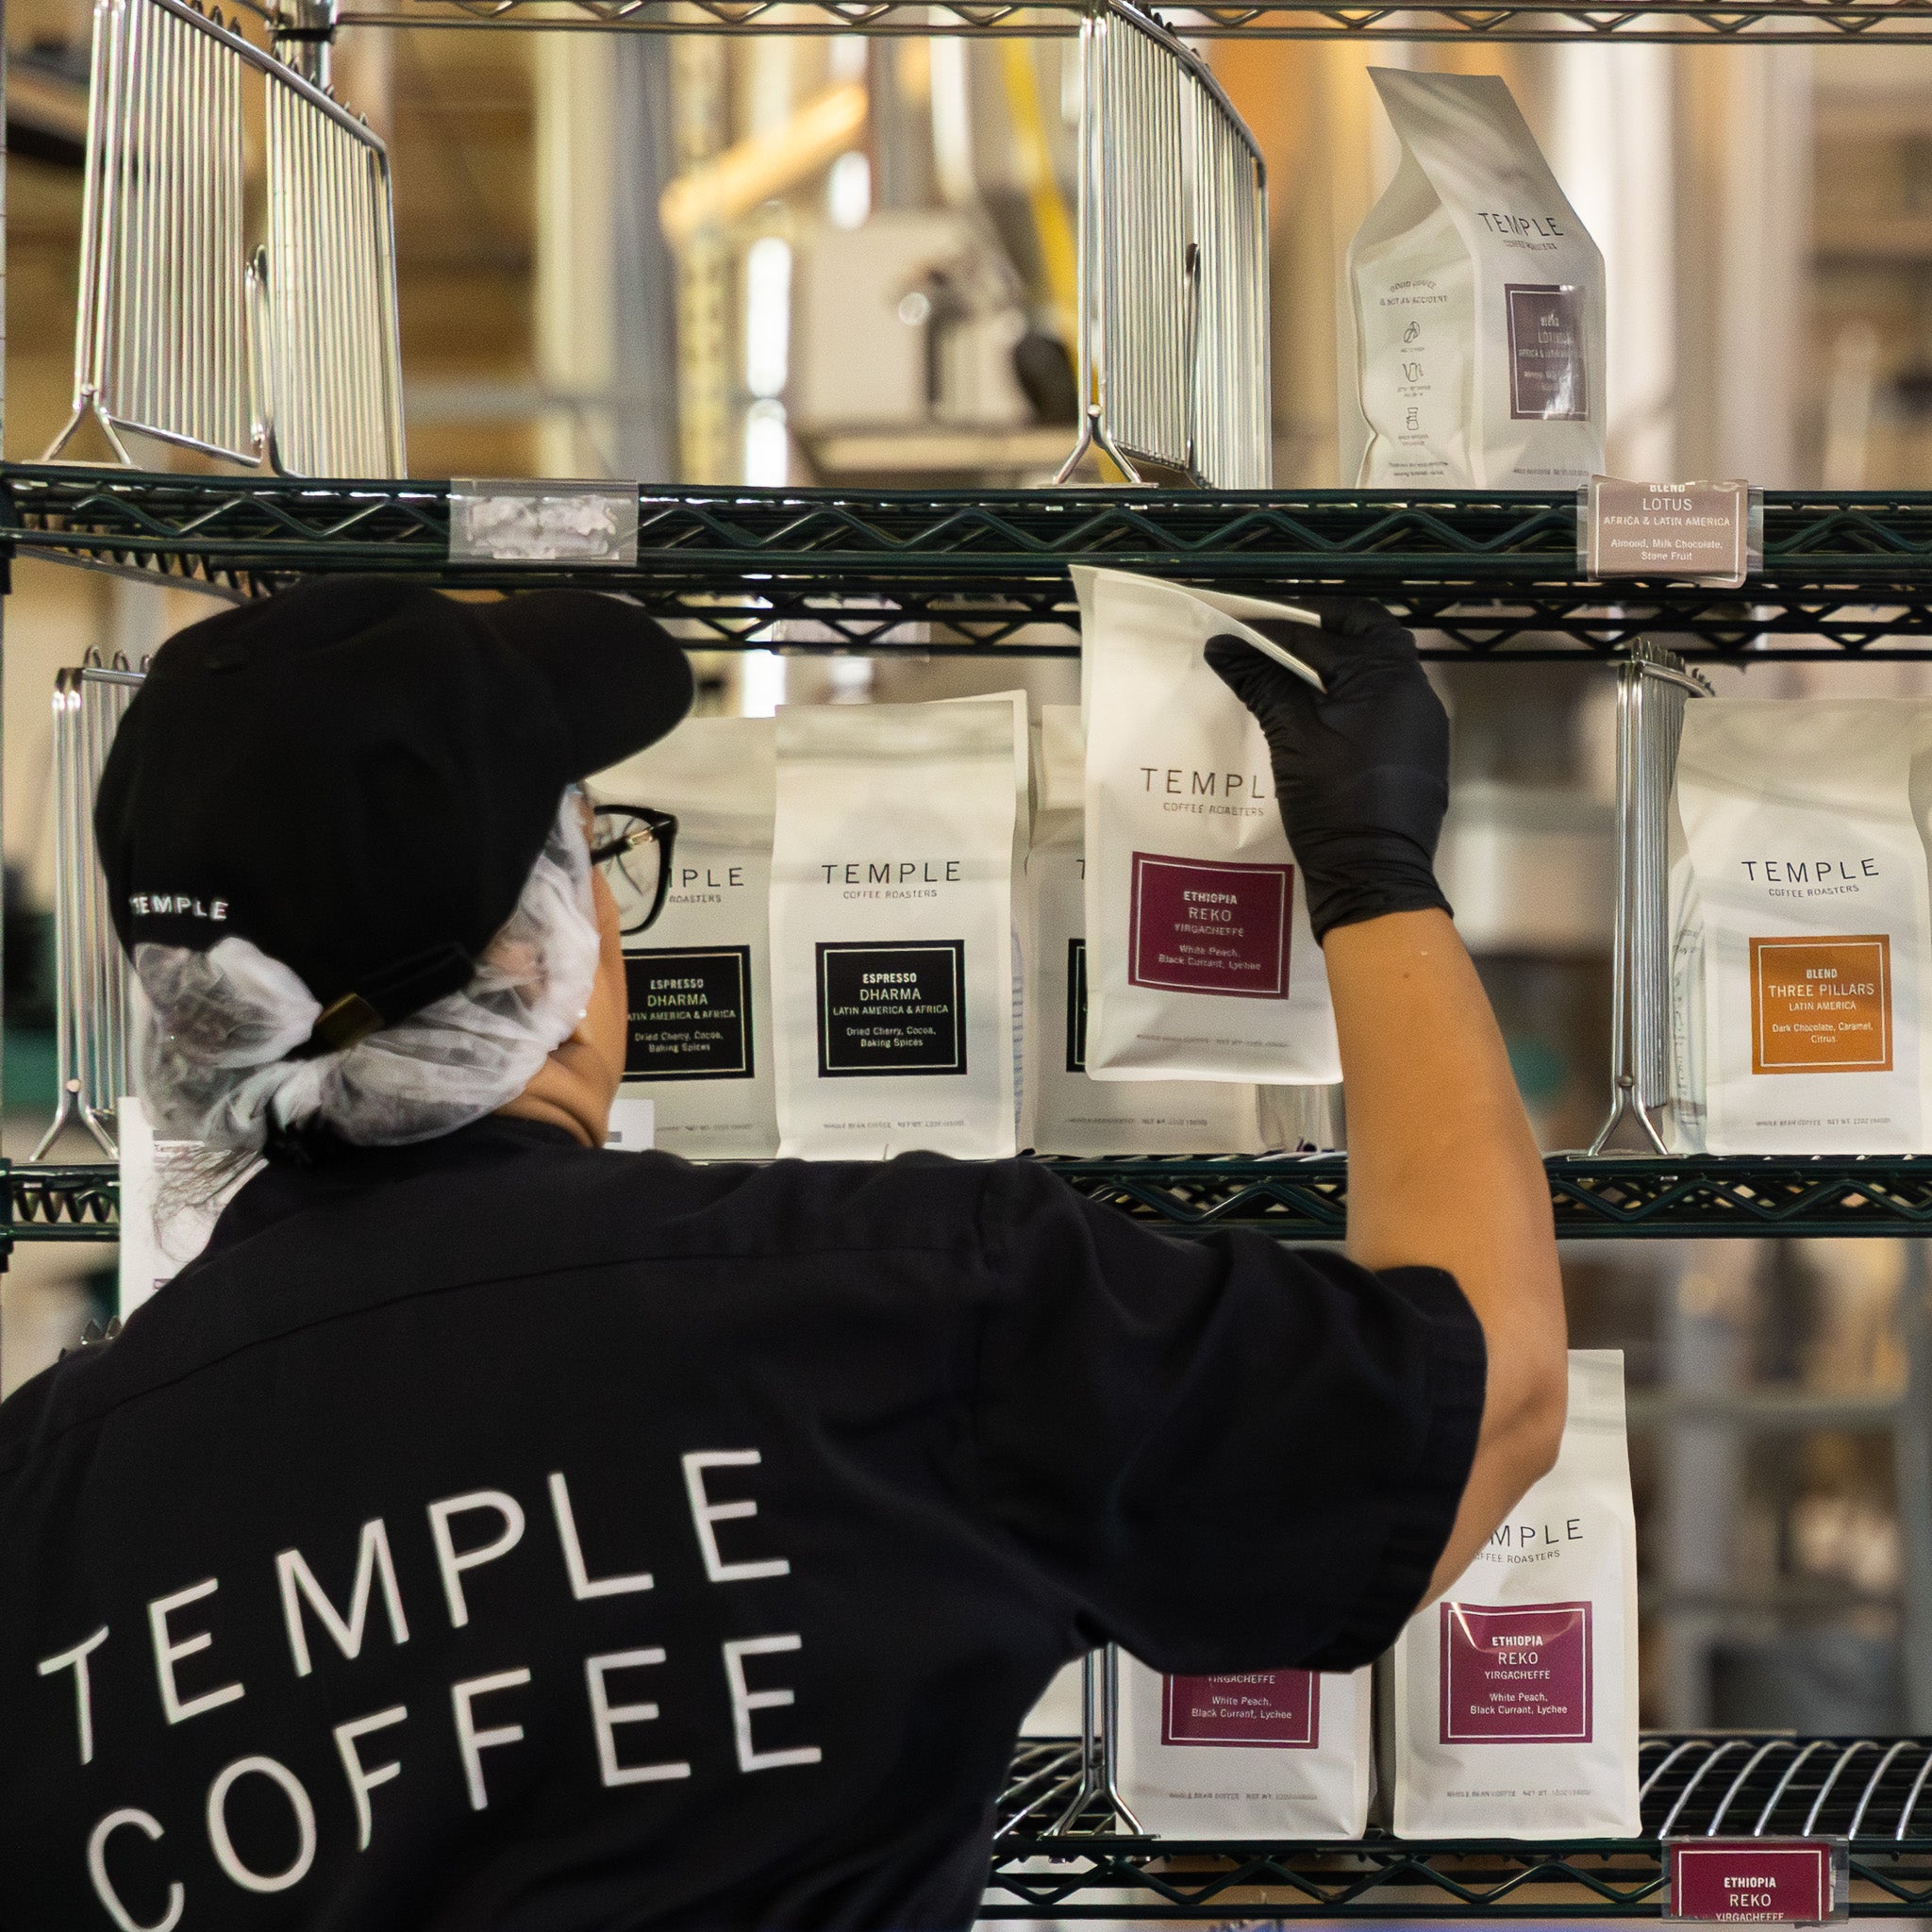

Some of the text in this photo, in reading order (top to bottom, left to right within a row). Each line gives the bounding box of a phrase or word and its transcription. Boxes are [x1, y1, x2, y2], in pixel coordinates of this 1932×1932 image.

[1477, 212, 1564, 236] TEMPLE
[1642, 497, 1692, 511] LOTUS
[1604, 516, 1730, 526] AFRICA & LATIN AMERICA
[1652, 539, 1672, 548] Milk
[1641, 551, 1692, 560] Stone Fruit
[1140, 767, 1265, 799] TEMPL
[822, 860, 961, 884] TEMPLE
[1740, 858, 1879, 883] TEMPLE
[842, 889, 938, 900] COFFEE ROASTERS
[1769, 884, 1859, 898] COFFEE ROASTERS
[1183, 891, 1238, 905] ETHIOPIA
[129, 895, 229, 921] TEMPLE
[1189, 907, 1232, 923] REKO
[1174, 923, 1244, 937] YIRGACHEFFE
[1179, 944, 1206, 955] White
[1158, 954, 1185, 964] Black
[862, 973, 917, 984] ESPRESSO
[1806, 968, 1838, 979] BLEND
[650, 978, 704, 990] ESPRESSO
[1768, 983, 1874, 997] THREE PILLARS
[647, 993, 708, 1008] DHARMA
[859, 988, 922, 1001] DHARMA
[833, 1005, 949, 1016] LATIN AMERICA & AFRICA
[1789, 1000, 1857, 1011] LATIN AMERICA
[627, 1009, 736, 1022] ATIN AMERICA & AFRICA
[846, 1026, 870, 1036] Dried
[1772, 1024, 1791, 1033] Dark
[860, 1038, 924, 1048] Baking Spices
[1810, 1035, 1836, 1044] Citrus
[1490, 1519, 1583, 1548] MPLE
[1507, 1549, 1560, 1564] ROASTERS
[37, 1449, 791, 1764] TEMPLE
[1491, 1635, 1543, 1647] ETHIOPIA
[1498, 1651, 1539, 1665] REKO
[1485, 1670, 1551, 1679] YIRGACHEFFE
[1211, 1695, 1238, 1706] White
[1489, 1692, 1515, 1702] White
[1191, 1707, 1217, 1718] Black
[1260, 1709, 1292, 1720] Lychee
[1470, 1705, 1495, 1715] Black
[1537, 1705, 1568, 1715] Lychee
[86, 1634, 822, 1932] COFFEE
[1724, 1876, 1776, 1889] ETHIOPIA
[1729, 1893, 1772, 1907] REKO
